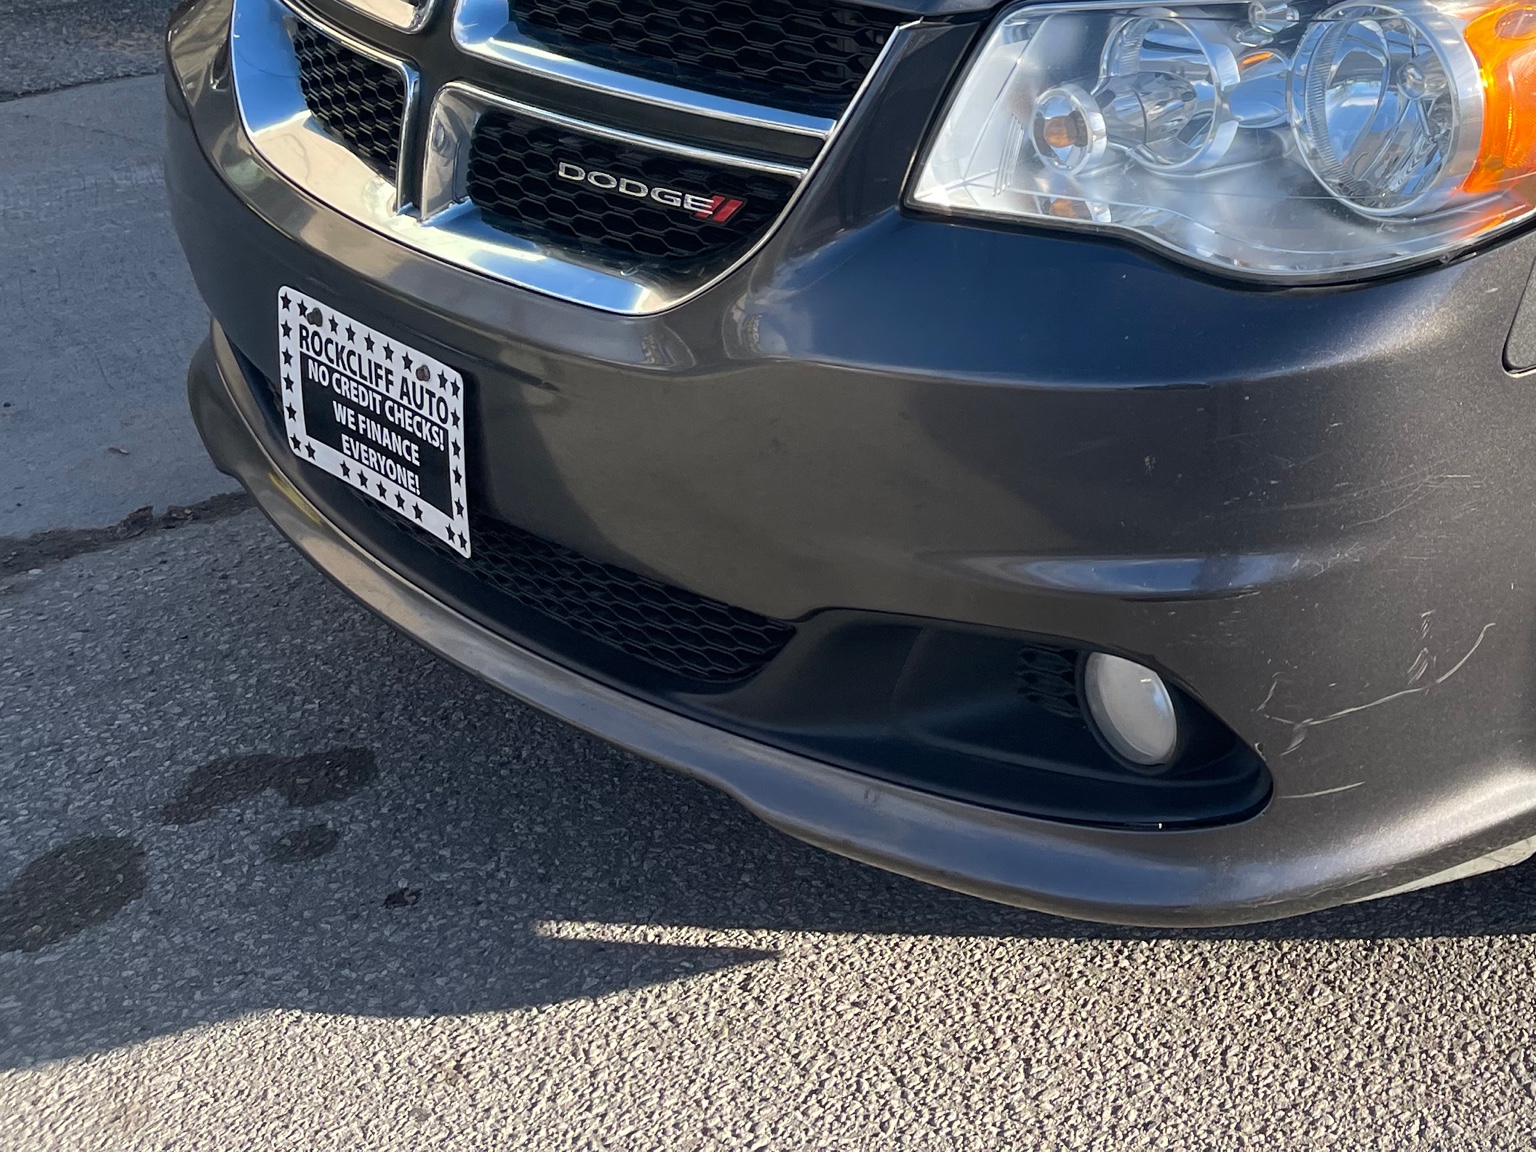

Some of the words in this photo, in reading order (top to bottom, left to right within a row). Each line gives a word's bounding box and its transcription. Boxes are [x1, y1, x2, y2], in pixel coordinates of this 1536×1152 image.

[558, 161, 714, 215] DODGE
[300, 324, 394, 394] ROCKCLIFF
[400, 375, 449, 425] AUTO
[308, 359, 329, 387] NO
[333, 372, 381, 415] CREDIT
[385, 399, 445, 451] CHECKS!
[333, 400, 357, 430] WE
[358, 413, 420, 466] FINANCE
[341, 434, 421, 495] EVERYONE!
